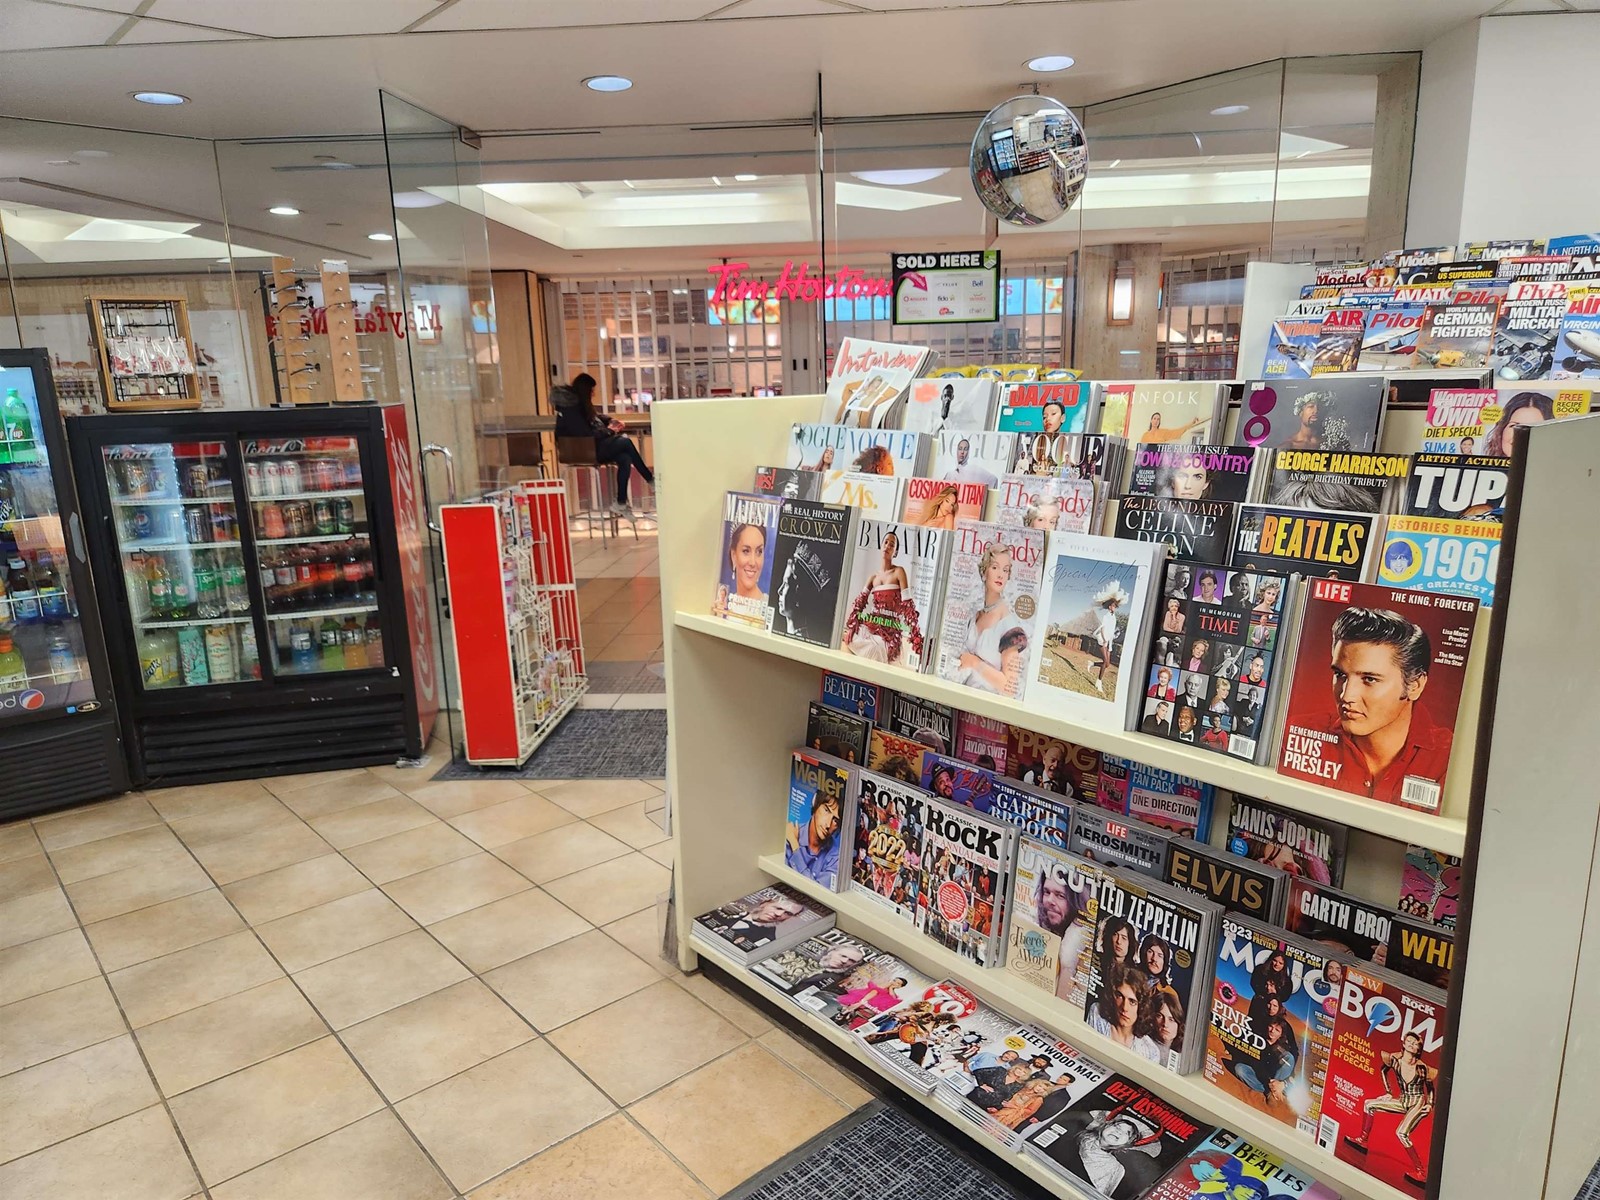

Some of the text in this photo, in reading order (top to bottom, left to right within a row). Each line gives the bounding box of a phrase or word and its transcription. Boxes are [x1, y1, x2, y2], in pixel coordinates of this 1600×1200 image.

[897, 253, 980, 269] SOLD HERE
[1399, 254, 1440, 268] Model
[1562, 245, 1590, 256] NORTH
[708, 262, 769, 304] Tim
[1437, 270, 1493, 280] US SUPERSONIC
[1323, 310, 1363, 327] AIR
[1370, 313, 1424, 329] Pilot
[1433, 312, 1494, 326] GERMAN
[1430, 325, 1493, 338] FIGHTERS
[837, 343, 923, 376] Interview
[1009, 384, 1080, 408] DAZED
[1119, 390, 1200, 406] KINFOLK
[1432, 391, 1497, 408] Woman's
[1559, 393, 1584, 401] FREE
[7, 423, 15, 439] 7
[1426, 425, 1484, 439] DIET SPECIAL
[849, 430, 915, 460] VOGUE
[1023, 434, 1105, 467] VOGUE
[1157, 444, 1229, 455] THE FAMILY ISSUE
[1424, 442, 1456, 453] SLIM &
[1033, 464, 1081, 475] COLLECTIONS
[1276, 451, 1409, 477] GEORGE HARRISON
[1417, 455, 1458, 464] ARTIST
[1289, 474, 1388, 488] AN BIRTHDAY TRIBUTE
[1413, 466, 1508, 512] TUP
[839, 480, 878, 509] Ms.
[724, 494, 781, 528] MAJESTY
[793, 507, 845, 521] REAL HISTORY
[1123, 497, 1229, 517] The LEGENDARY
[780, 516, 843, 540] CROWN
[1125, 511, 1217, 537] CELINE
[1396, 519, 1449, 534] STORIES
[957, 529, 988, 556] The
[1136, 530, 1198, 556] DION
[1238, 531, 1259, 552] THE
[1259, 515, 1366, 565] BEATLES
[1315, 582, 1350, 600] LIFE
[1427, 581, 1488, 594] GREATEST
[1391, 592, 1474, 612] THE KING, FOREVER
[1208, 609, 1242, 619] MEMORIAM
[1199, 616, 1239, 635] TIME
[824, 676, 877, 707] BEATLES
[1286, 733, 1321, 757] ELVIS
[1289, 725, 1339, 744] REMEMBERING
[964, 739, 1008, 759] TAYLOR SWIFT
[1016, 732, 1097, 771] PROG
[1283, 752, 1342, 781] PRESLEY
[794, 760, 845, 798] Weller
[1132, 772, 1175, 794] FAN PACK
[880, 785, 902, 797] CLASSIC
[1001, 785, 1065, 814] STORY AMERICAN ICON
[860, 779, 925, 826] ROCK
[997, 793, 1058, 828] GARTH
[1132, 794, 1198, 818] ONE DIRECTION
[947, 813, 973, 828] CLASSIC
[991, 805, 1064, 847] BROOKS
[1106, 822, 1127, 838] LIFE
[924, 831, 938, 843] THE
[925, 804, 1002, 861] ROCK
[1231, 803, 1330, 861] JANIS JOPLIN
[868, 830, 906, 863] 2022
[1074, 825, 1161, 864] AEROSMITH
[1080, 838, 1152, 869] AMERICA'S GREATEST ROCK BAND
[1019, 850, 1100, 898] UNCUT
[1170, 850, 1264, 910] ELVIS
[1100, 882, 1198, 953] LED ZEPPELIN
[1300, 890, 1350, 930] GARTH
[1222, 919, 1252, 941] 2023
[1252, 939, 1278, 950] PREVIEW
[1286, 945, 1322, 963] IGGY POP
[1293, 954, 1306, 963] THE
[1307, 959, 1322, 969] RAW
[1212, 999, 1253, 1031] PINK
[1401, 995, 1435, 1016] ROCK
[1210, 1011, 1267, 1051] FLOYD
[1343, 1031, 1371, 1049] ALBUM
[1017, 1028, 1101, 1083] FLEETWOOD MAC
[1055, 1041, 1078, 1058] LIFE
[1338, 1034, 1375, 1058] BY ALBUM
[1339, 1045, 1371, 1065] DECADE
[1333, 1049, 1375, 1075] BY DECADE
[1105, 1081, 1200, 1140] OZZY OSBOURNE
[1254, 1148, 1269, 1158] THE
[1232, 1141, 1307, 1192] BEATLES
[1165, 1178, 1198, 1197] ALBUM
